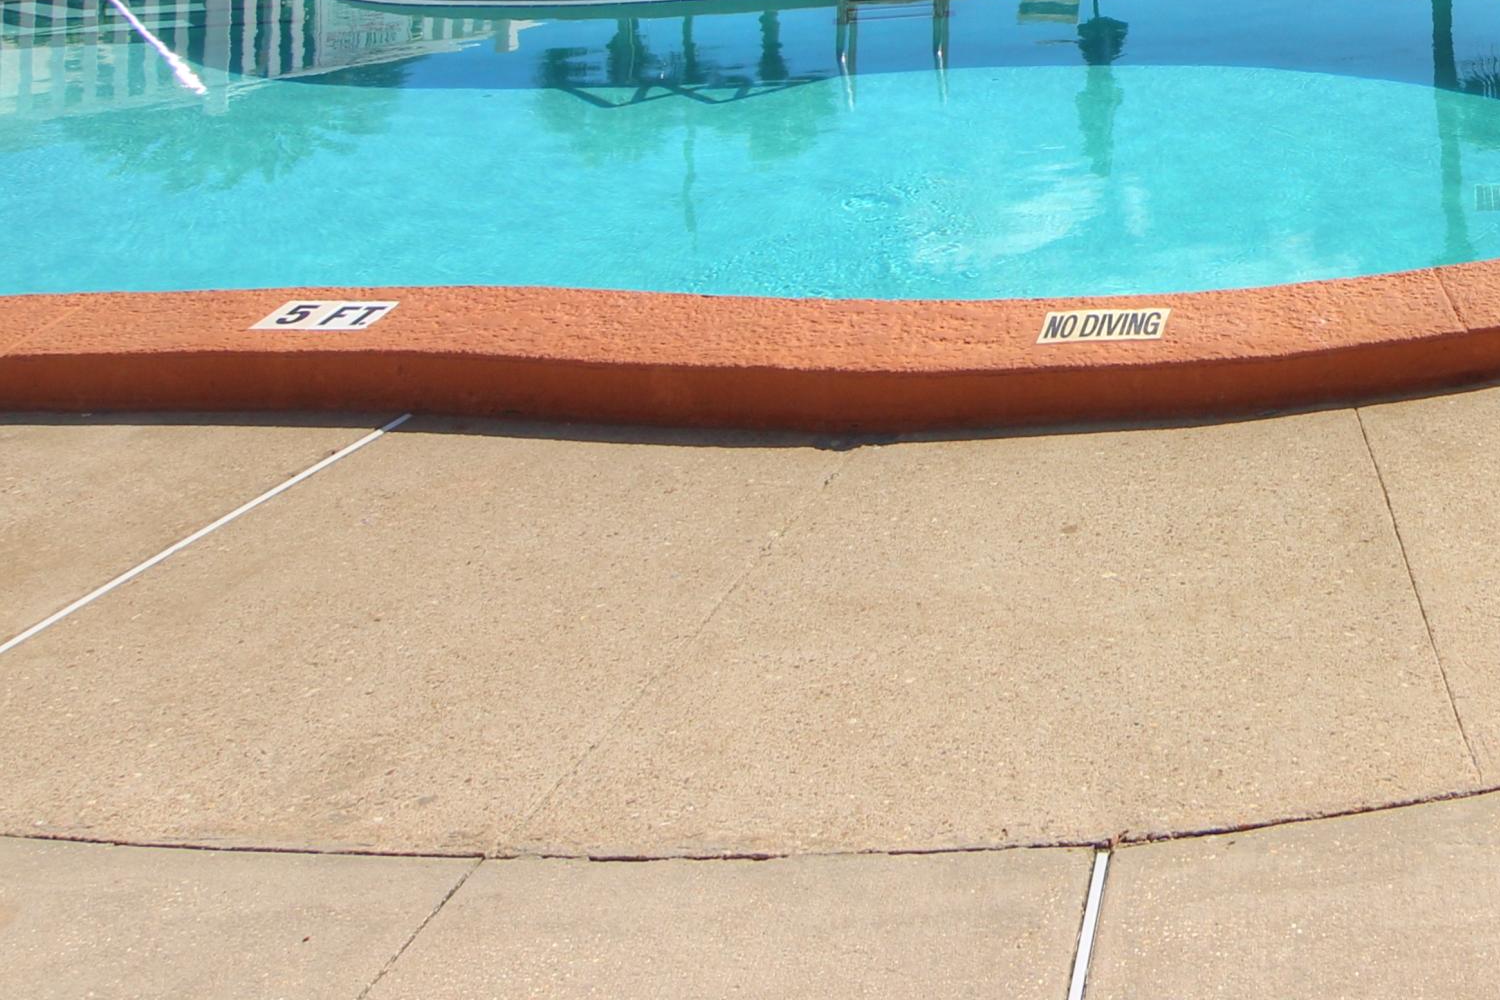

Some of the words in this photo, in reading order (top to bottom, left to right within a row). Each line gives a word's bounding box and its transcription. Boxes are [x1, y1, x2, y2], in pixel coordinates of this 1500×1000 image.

[275, 305, 321, 325] 5
[1043, 314, 1078, 339] NO
[1079, 311, 1162, 338] DIVING
